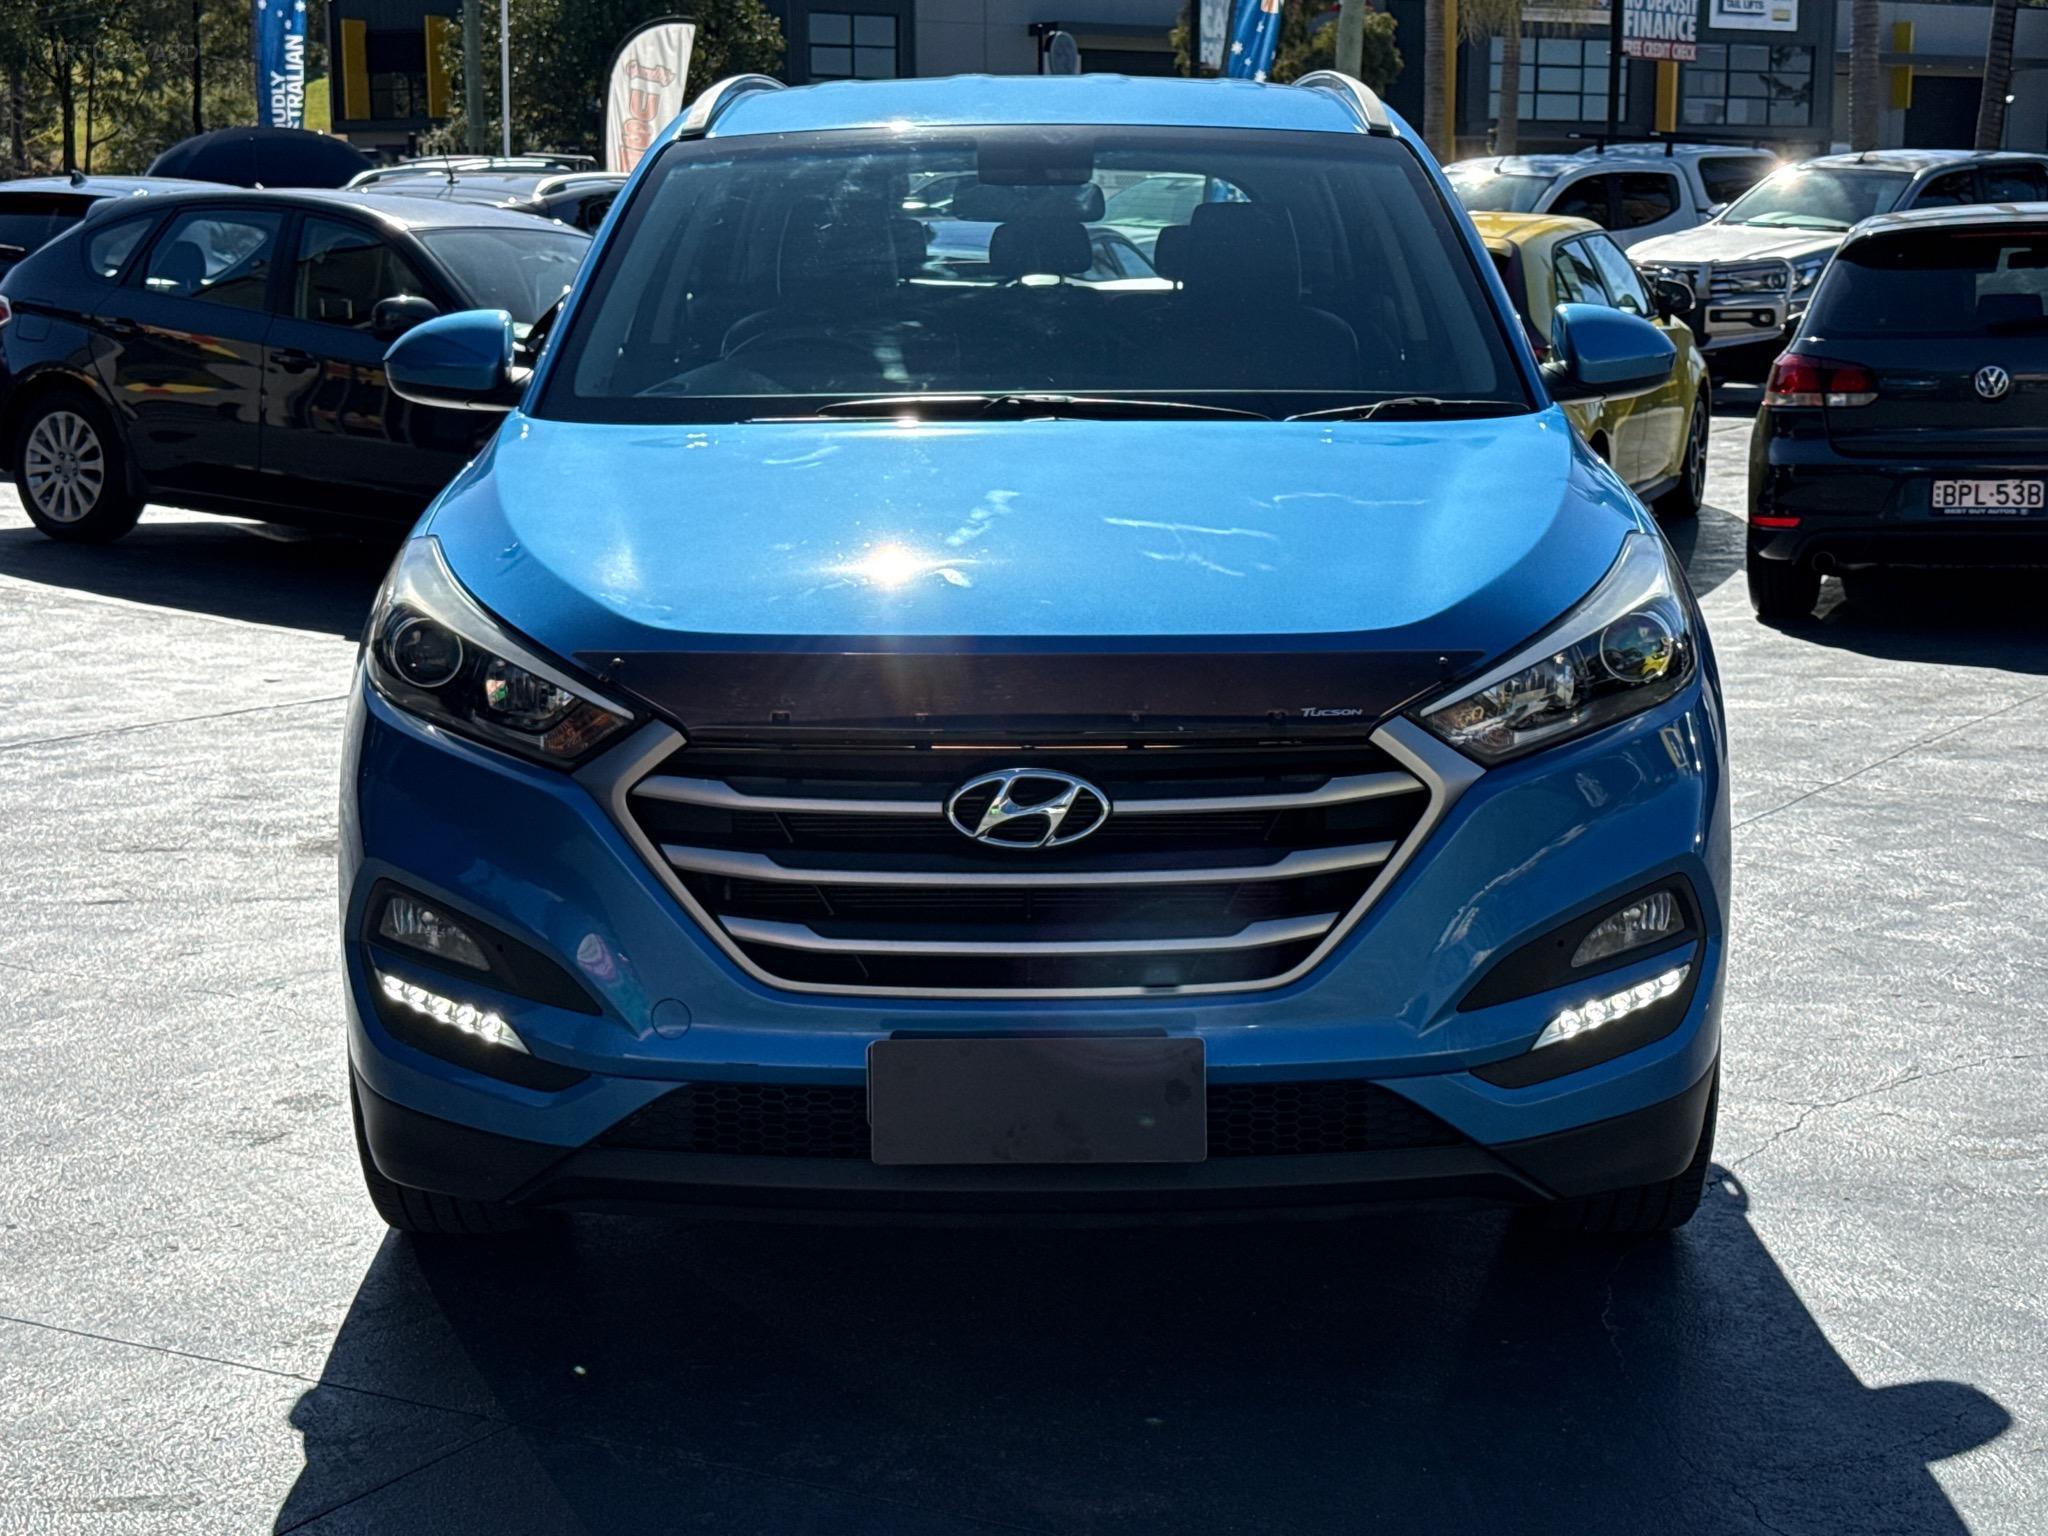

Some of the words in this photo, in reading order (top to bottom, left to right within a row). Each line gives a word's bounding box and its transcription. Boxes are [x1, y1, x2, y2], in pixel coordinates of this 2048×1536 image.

[1623, 9, 1697, 42] FINANCE
[1643, 41, 1671, 58] CREDIT
[1301, 707, 1363, 717] TUCSON
